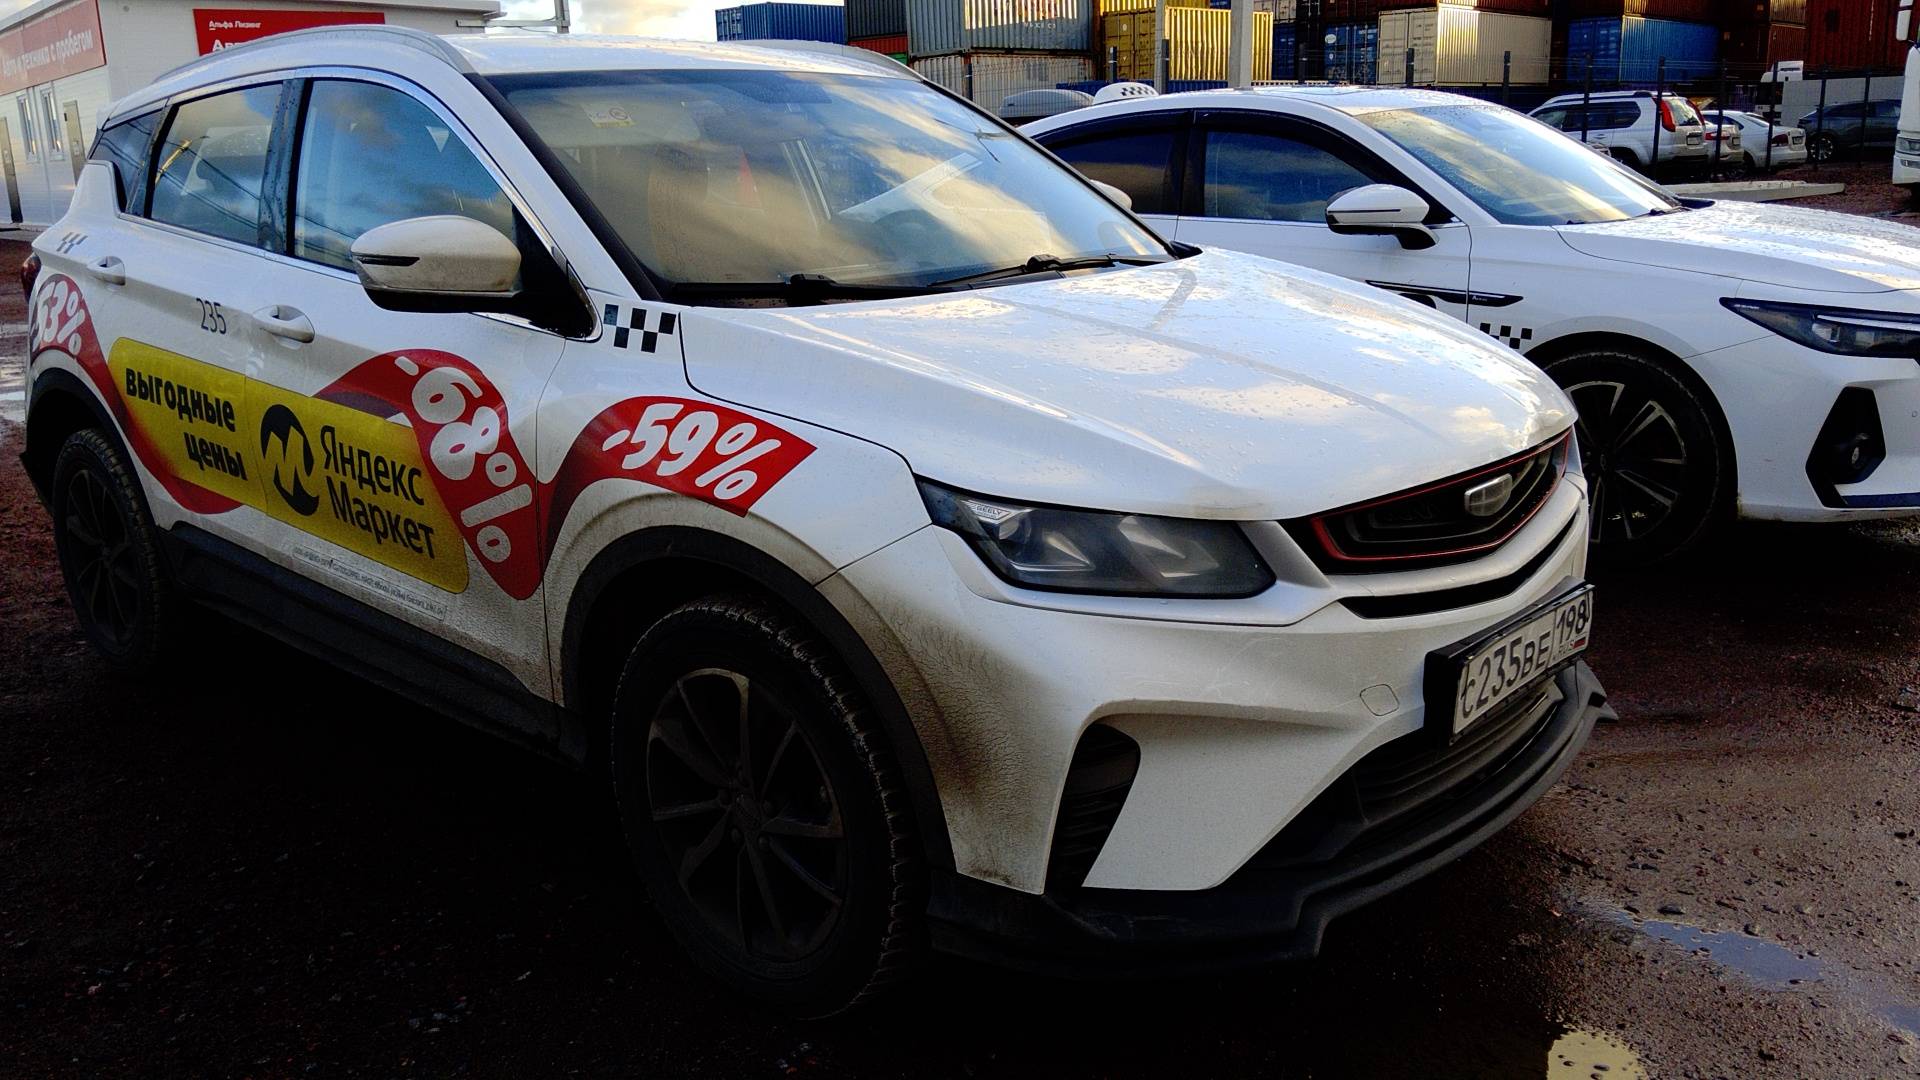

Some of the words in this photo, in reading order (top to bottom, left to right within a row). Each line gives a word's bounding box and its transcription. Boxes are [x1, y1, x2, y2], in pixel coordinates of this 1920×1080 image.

[196, 297, 227, 335] 235
[125, 367, 236, 433] выгодные
[183, 431, 249, 482] цены
[320, 424, 425, 507] Яндекс
[394, 354, 535, 564] -68%
[602, 402, 782, 500] -59%
[326, 475, 436, 560] Маркет
[1556, 599, 1587, 645] 198
